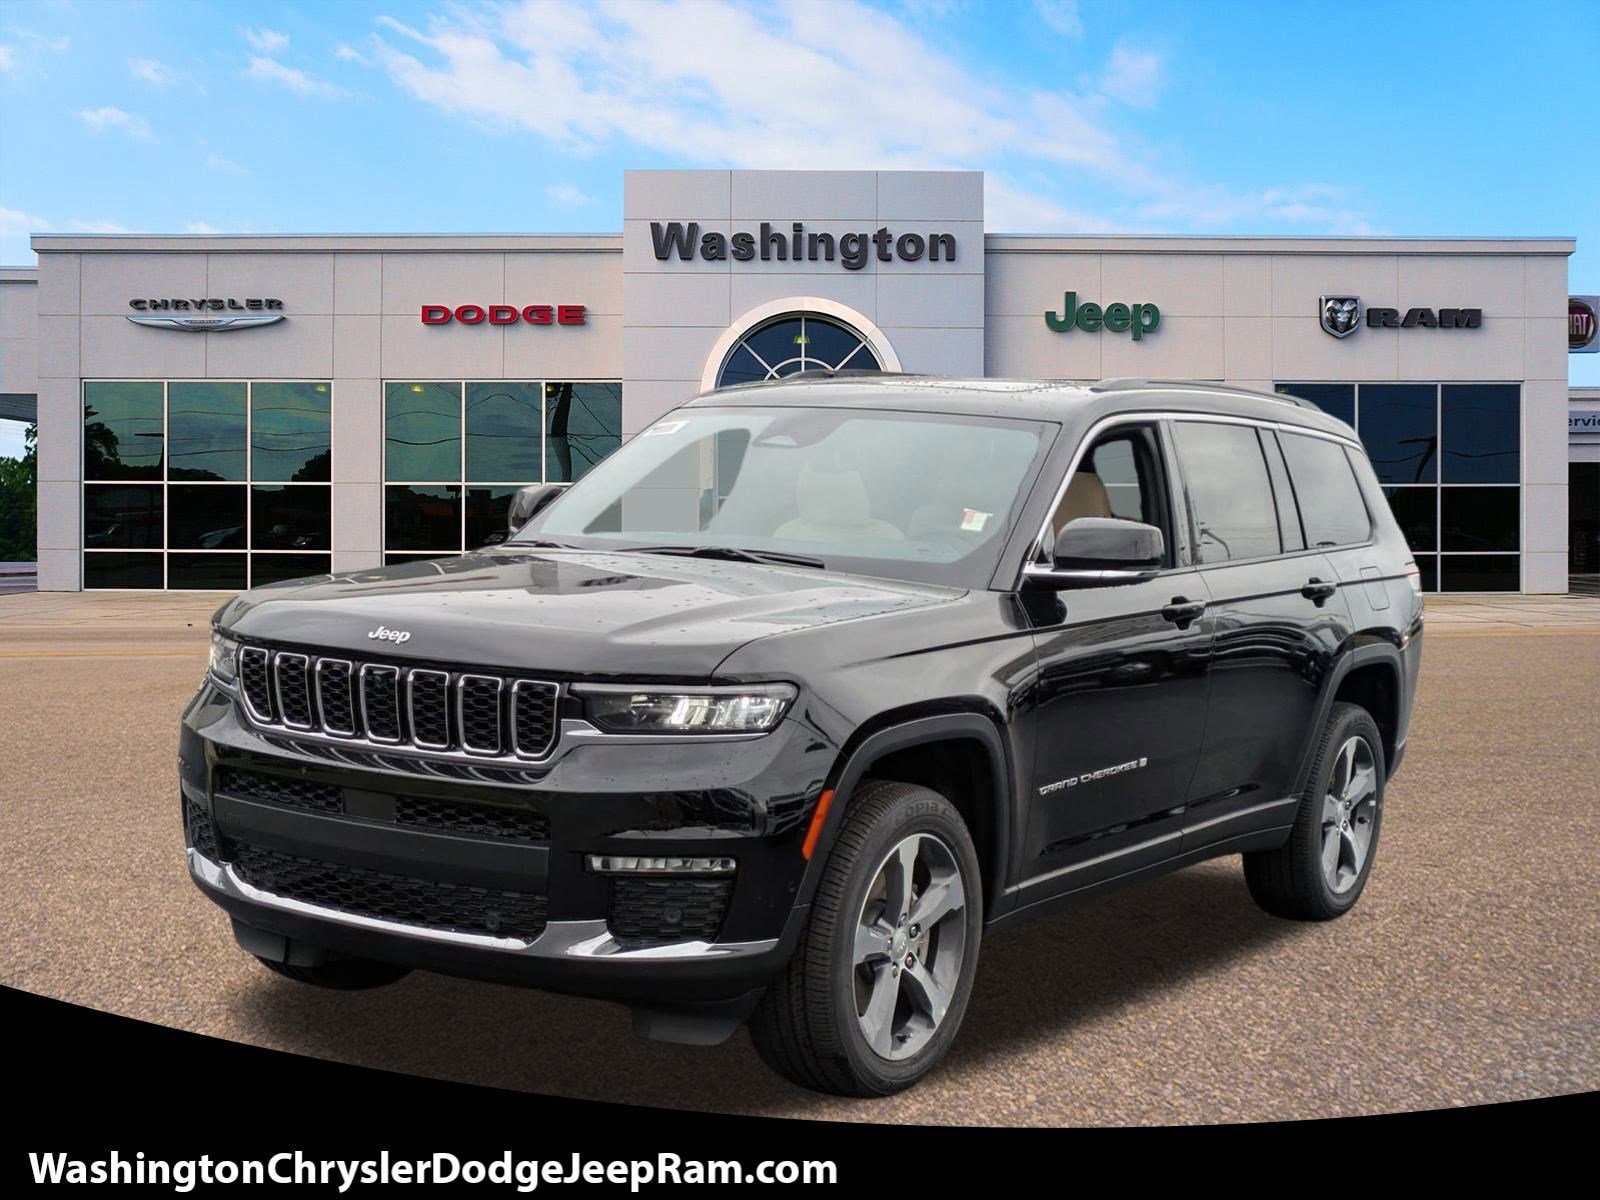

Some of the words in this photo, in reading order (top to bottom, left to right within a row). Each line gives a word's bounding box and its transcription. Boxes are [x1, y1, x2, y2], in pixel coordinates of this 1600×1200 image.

[649, 221, 957, 270] Washington
[128, 298, 285, 311] CHRYSLER
[421, 304, 587, 326] DODGE
[1044, 290, 1161, 341] Jeep
[1366, 307, 1483, 329] RAM
[1568, 313, 1589, 336] IAT
[367, 625, 412, 645] Jeep
[1039, 776, 1079, 796] GRAND
[1079, 759, 1139, 783] CHEROKEE
